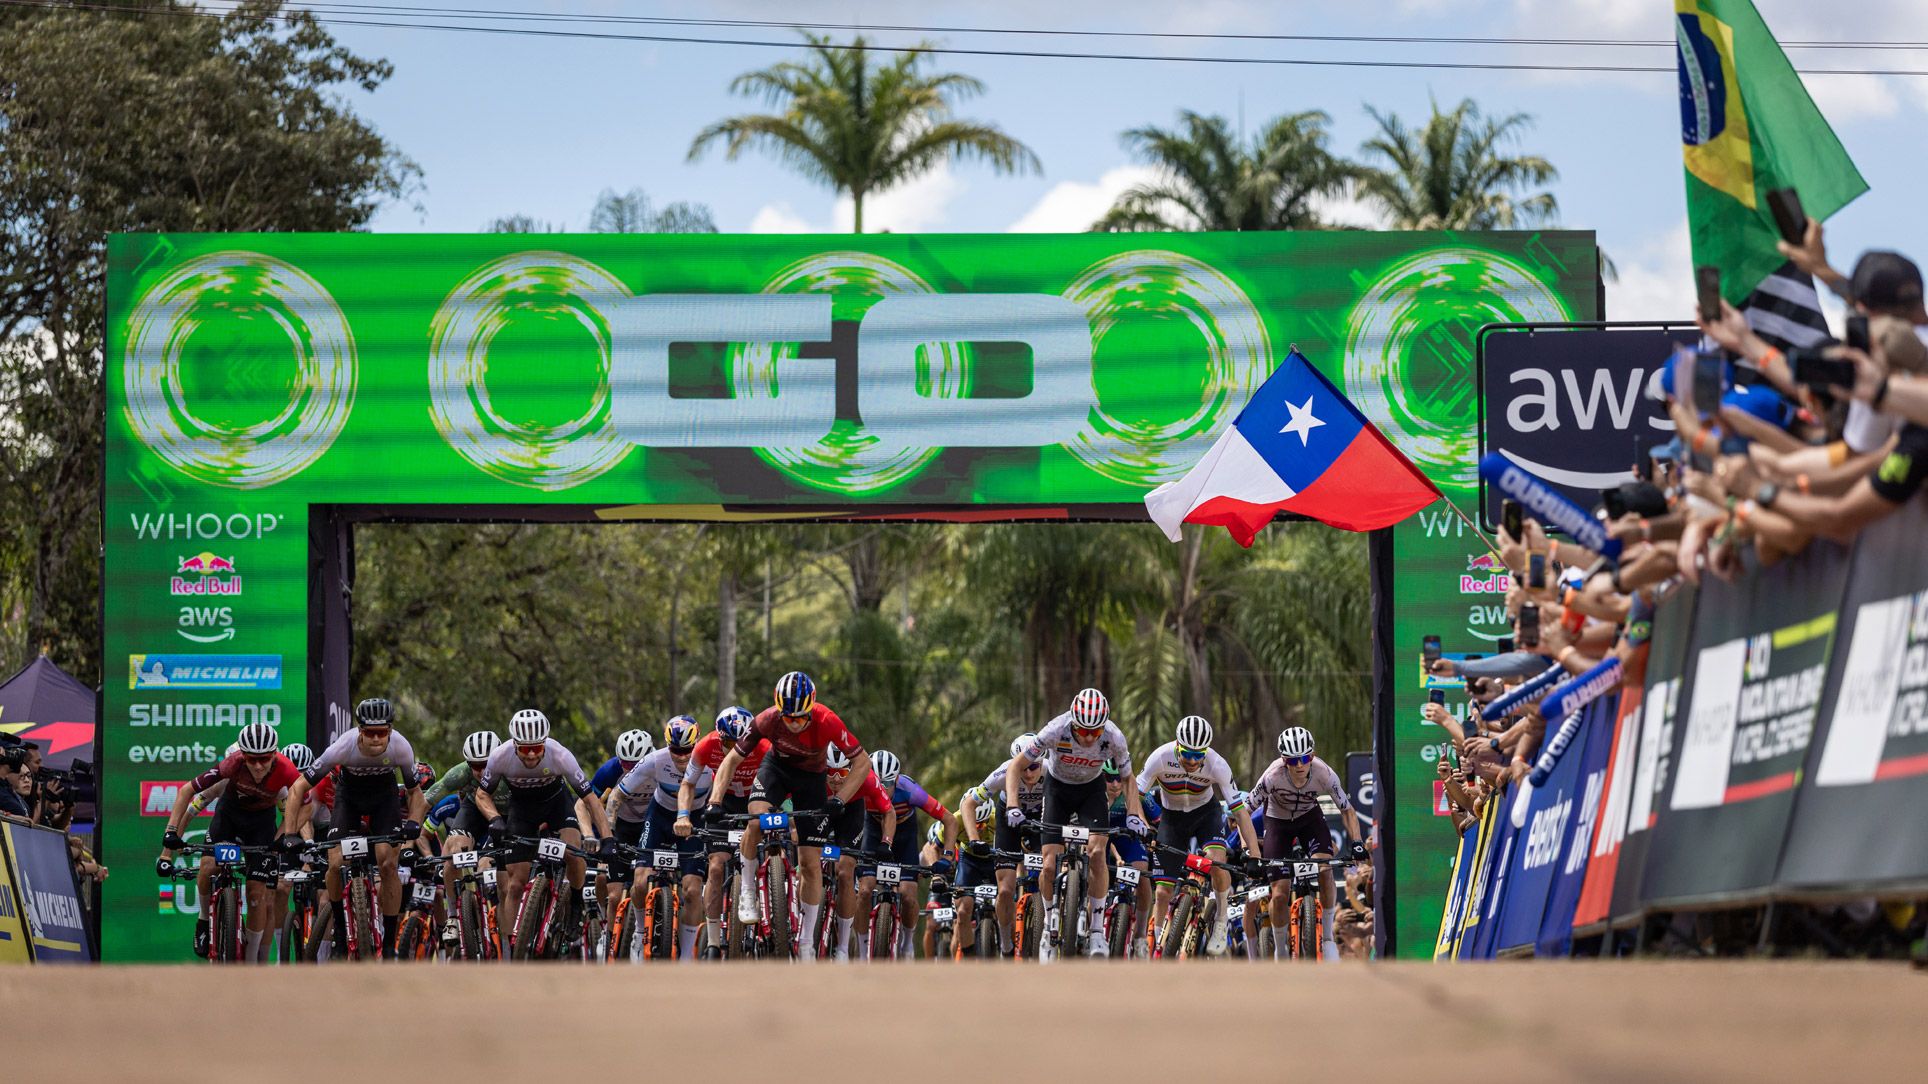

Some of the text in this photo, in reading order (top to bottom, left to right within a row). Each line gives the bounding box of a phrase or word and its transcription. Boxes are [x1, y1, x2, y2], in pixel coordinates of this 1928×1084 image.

[611, 293, 1092, 447] GO
[131, 513, 279, 539] WHOOP
[171, 576, 242, 595] Red Bull
[1460, 574, 1495, 593] Red
[179, 606, 233, 627] aws
[1469, 605, 1508, 625] aw
[171, 667, 279, 680] MICHELIN
[129, 703, 282, 727] SHIMANO
[1060, 754, 1104, 768] BMC
[765, 815, 783, 826] 18
[1071, 829, 1080, 838] 9
[350, 841, 360, 851] 2
[544, 844, 560, 856] 10
[823, 846, 833, 855] 8
[220, 848, 237, 860] 70
[457, 853, 474, 862] 12
[658, 856, 673, 866] 69
[1298, 863, 1314, 873] 27
[881, 869, 897, 880] 16
[1121, 870, 1136, 880] 14
[418, 886, 432, 897] 15
[35, 891, 83, 930] MICHELIN
